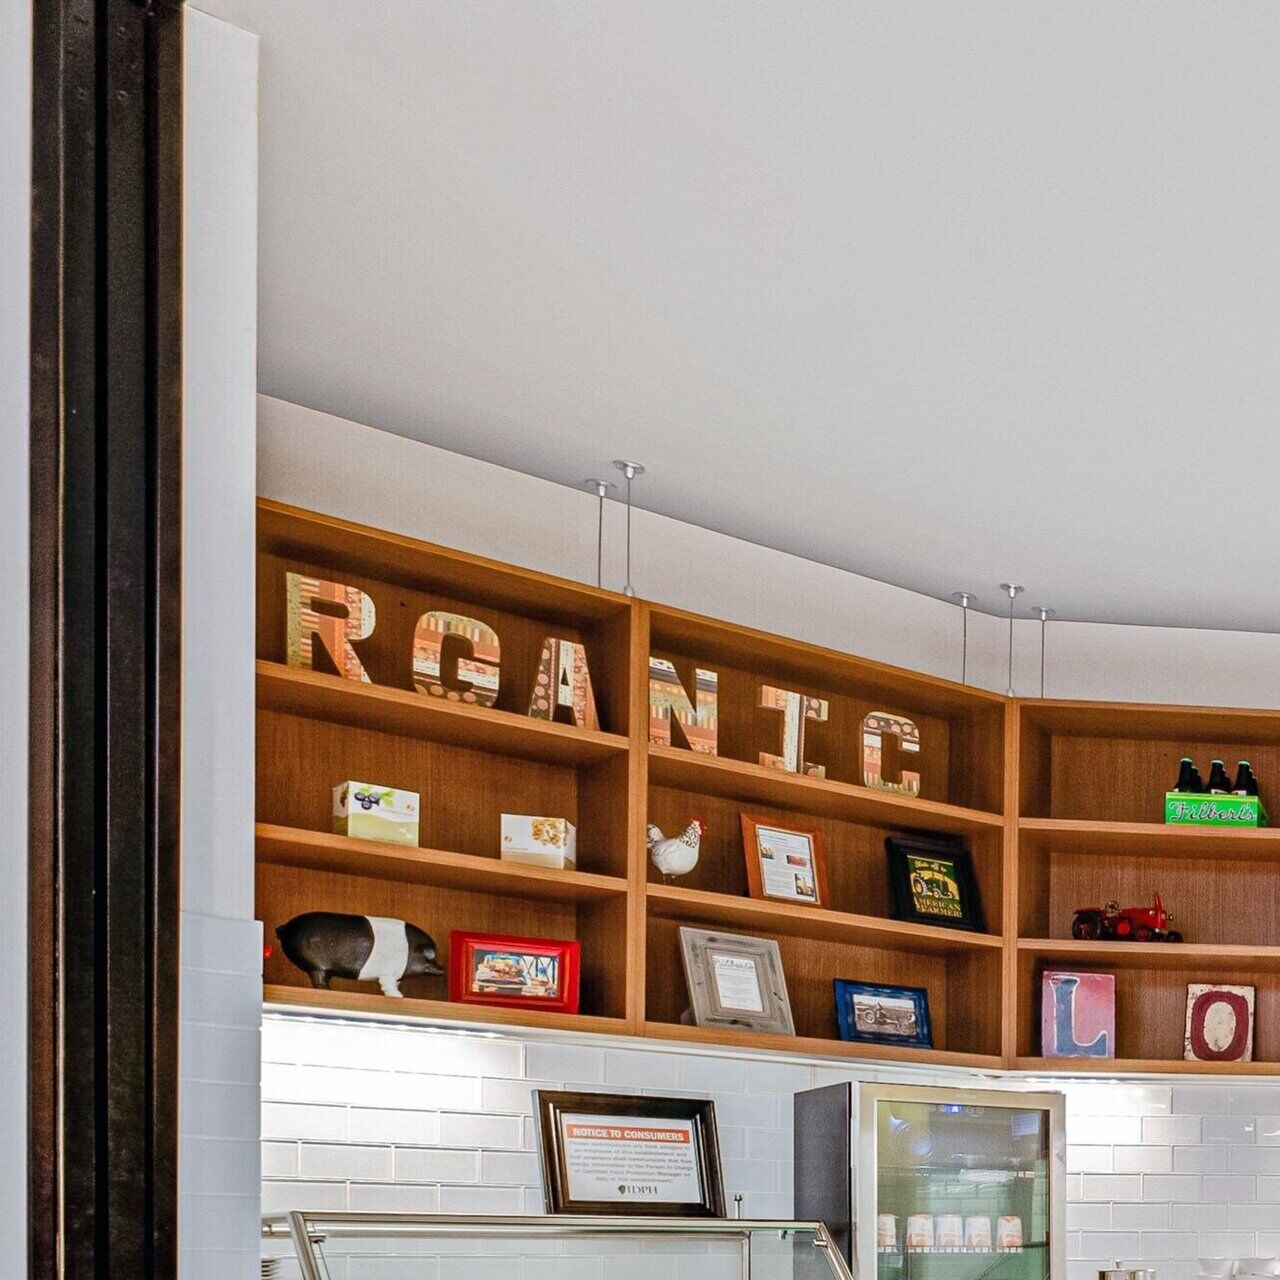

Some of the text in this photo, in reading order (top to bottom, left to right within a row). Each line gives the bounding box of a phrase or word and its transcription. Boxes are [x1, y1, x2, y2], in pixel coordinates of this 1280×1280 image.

[1169, 800, 1257, 821] Filbert's
[572, 1128, 684, 1141] NOTICE TO CONSUMERS
